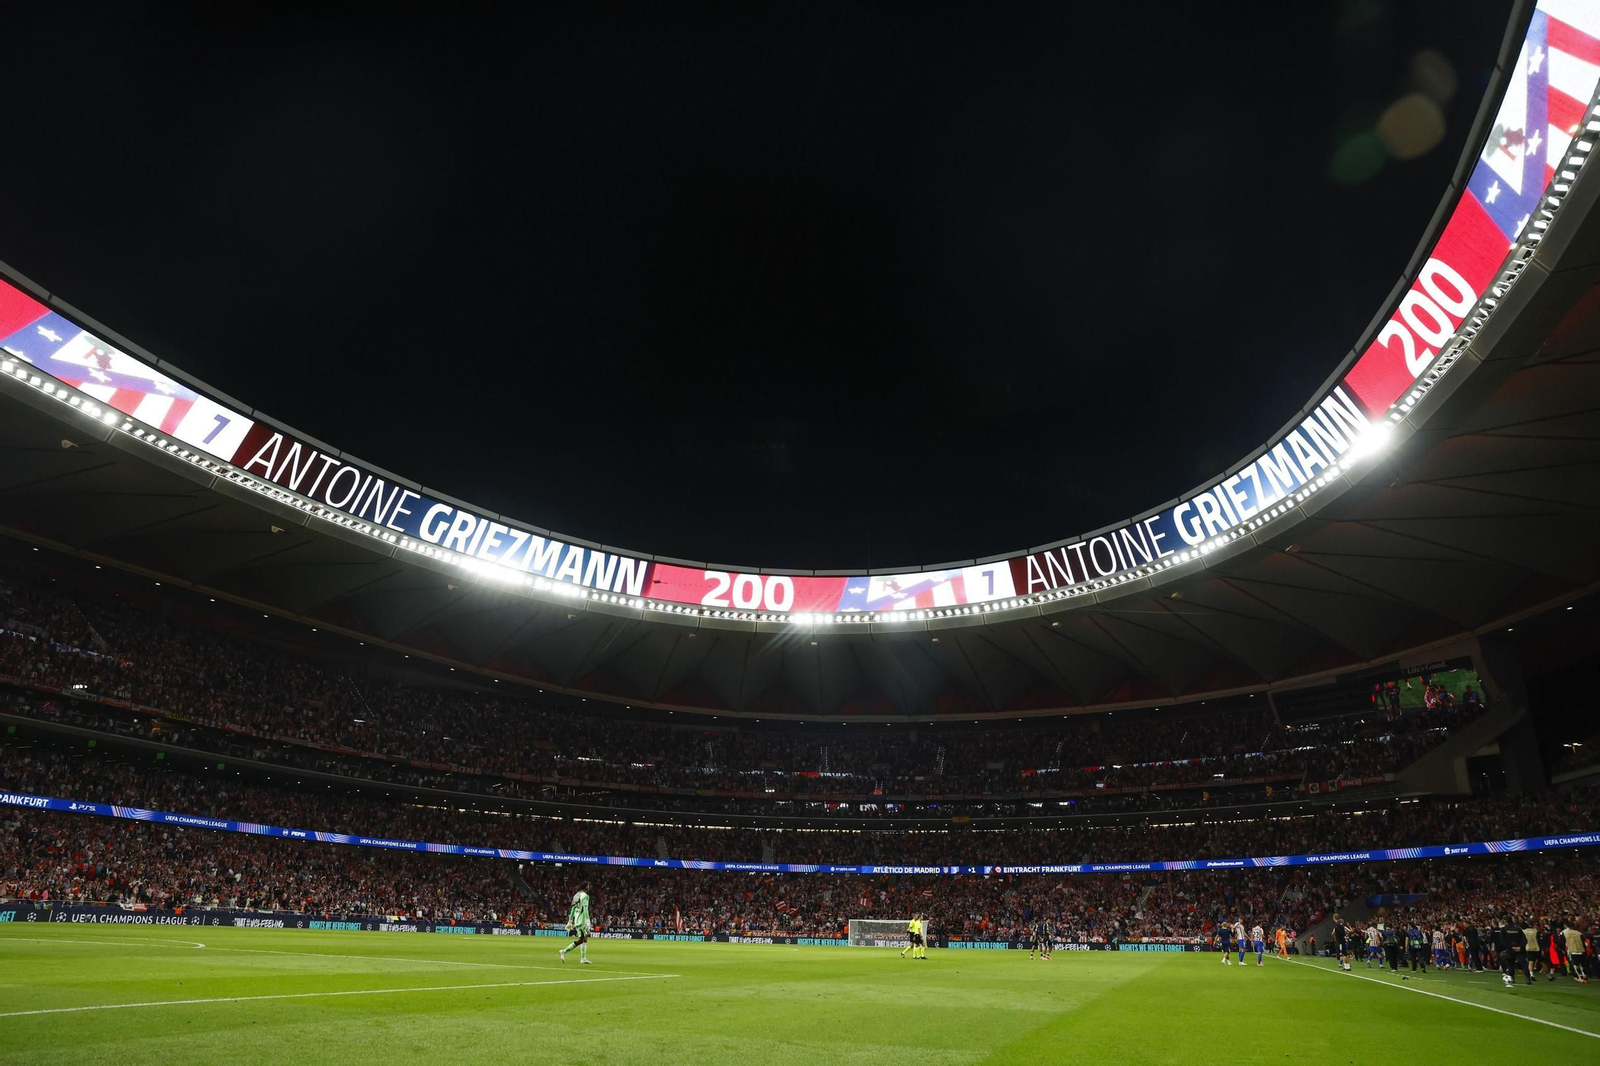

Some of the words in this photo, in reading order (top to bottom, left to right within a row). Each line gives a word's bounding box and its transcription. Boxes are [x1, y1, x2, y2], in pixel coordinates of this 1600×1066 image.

[1378, 257, 1478, 379] 200
[203, 414, 231, 445] 7
[1026, 515, 1175, 595] ANTOINE
[1173, 385, 1373, 546] GRIEZMANN
[243, 432, 421, 532] ANTOINE
[418, 503, 648, 596] GRIEZMANN
[700, 570, 795, 611] 200
[982, 570, 994, 595] 7
[179, 817, 208, 826] CHAMPIONS
[208, 820, 228, 828] LEAGUE
[873, 865, 903, 874] ATLÉTICO
[1003, 866, 1041, 874] EINTRACHT
[72, 914, 96, 923] UEFA
[100, 914, 153, 924] CHAMPIONS
[156, 917, 188, 925] LEAGUE
